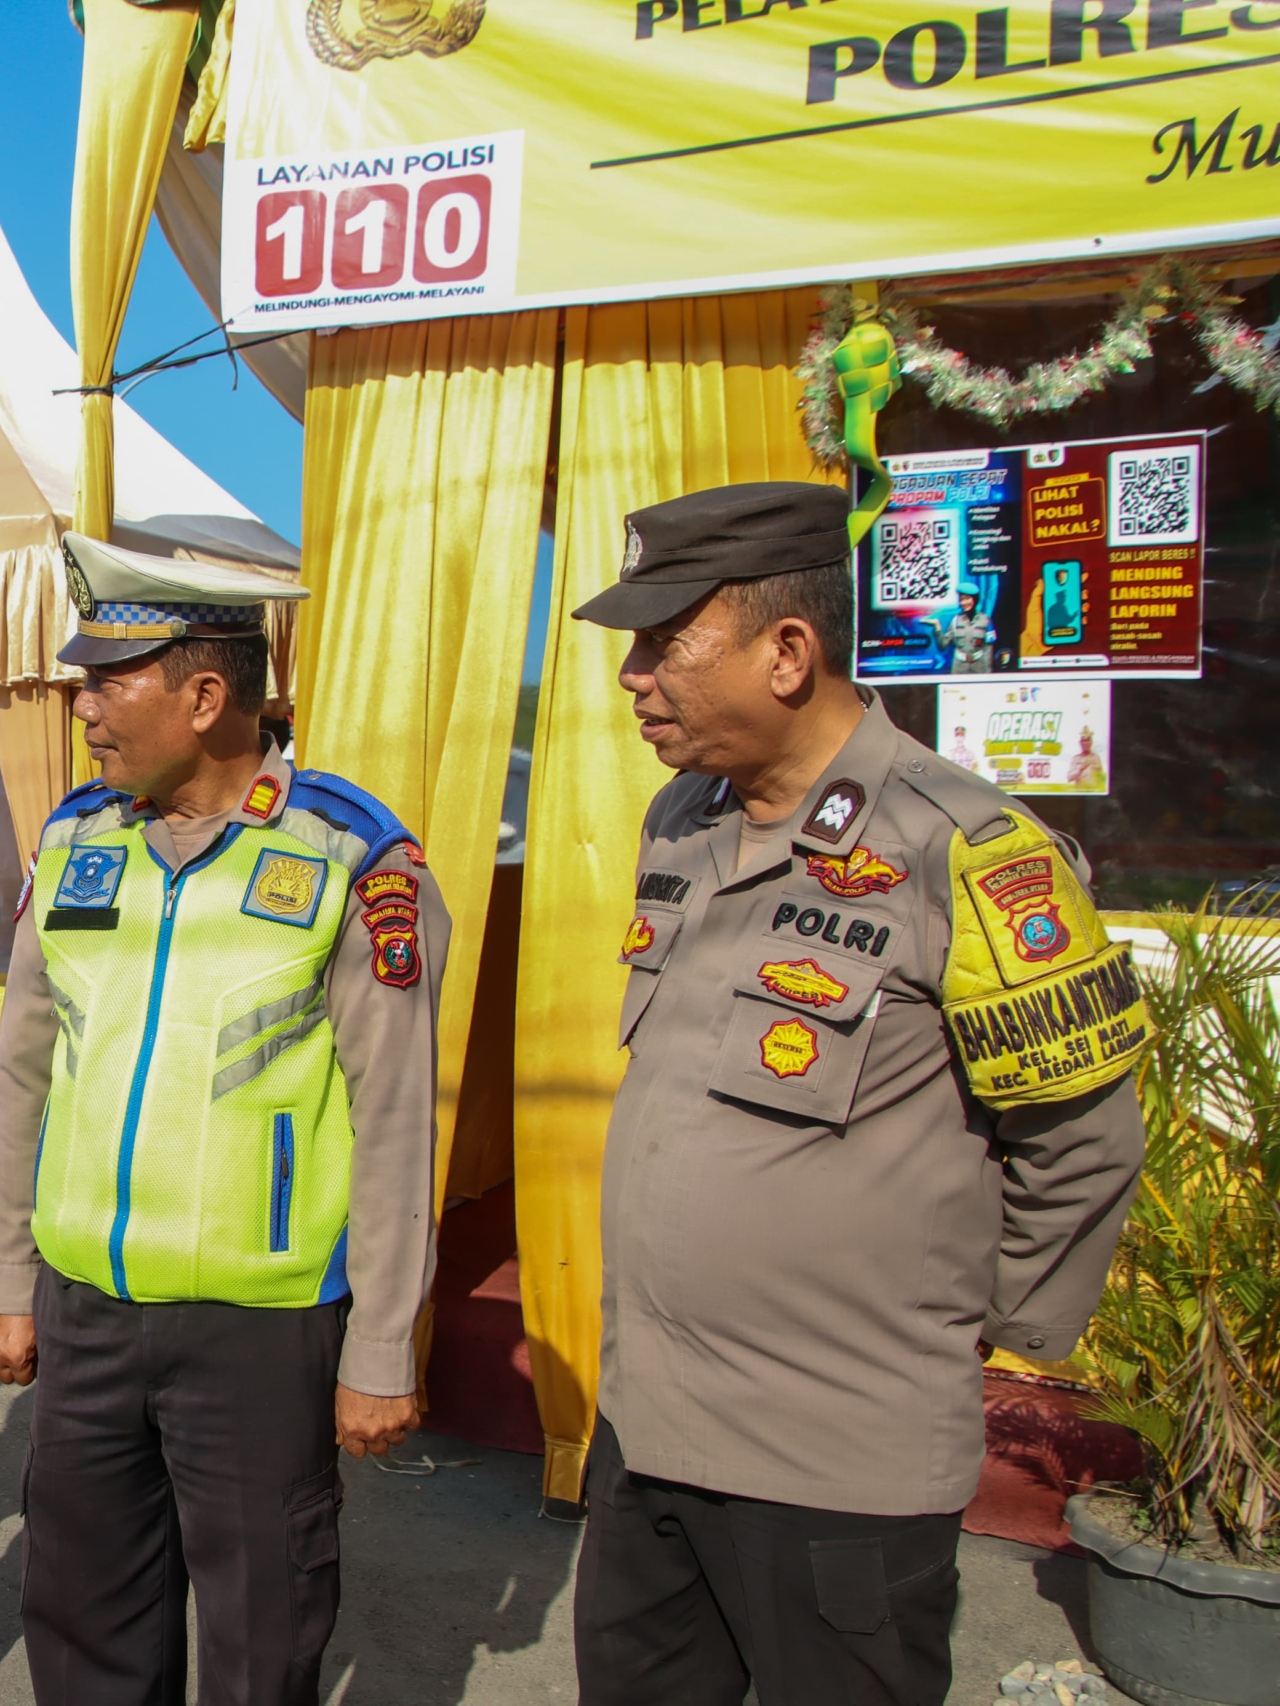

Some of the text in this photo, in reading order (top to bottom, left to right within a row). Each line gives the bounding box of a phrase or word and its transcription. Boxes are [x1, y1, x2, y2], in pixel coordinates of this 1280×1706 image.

[635, 0, 838, 40] PEL
[257, 144, 495, 186] LAYANAN POLISI
[265, 192, 482, 281] 110
[254, 285, 485, 313] MELINDUNGI-MENGAYOMI-MELAYANI
[960, 468, 1008, 486] CEPAT
[888, 485, 991, 505] PROPAM POLRI
[1034, 485, 1080, 503] LIHAT
[1035, 503, 1084, 521] POLISI
[1035, 518, 1101, 539] NAKAL?
[1109, 551, 1132, 563] SCAN
[1132, 549, 1160, 562] LAPOR
[1161, 548, 1189, 560] BERES
[1110, 565, 1184, 582] MENDING
[1110, 584, 1195, 601] LANGSUNG
[1110, 603, 1177, 619] LAPORIN
[986, 711, 1063, 743] OPERASI
[366, 874, 407, 890] POLRES
[985, 860, 1046, 888] POLRES
[772, 903, 890, 957] POLRI
[1065, 1034, 1091, 1056] SEI
[1097, 1017, 1129, 1045] MATI
[991, 1072, 1028, 1092] KEC.
[1038, 1051, 1095, 1083] MEDAN
